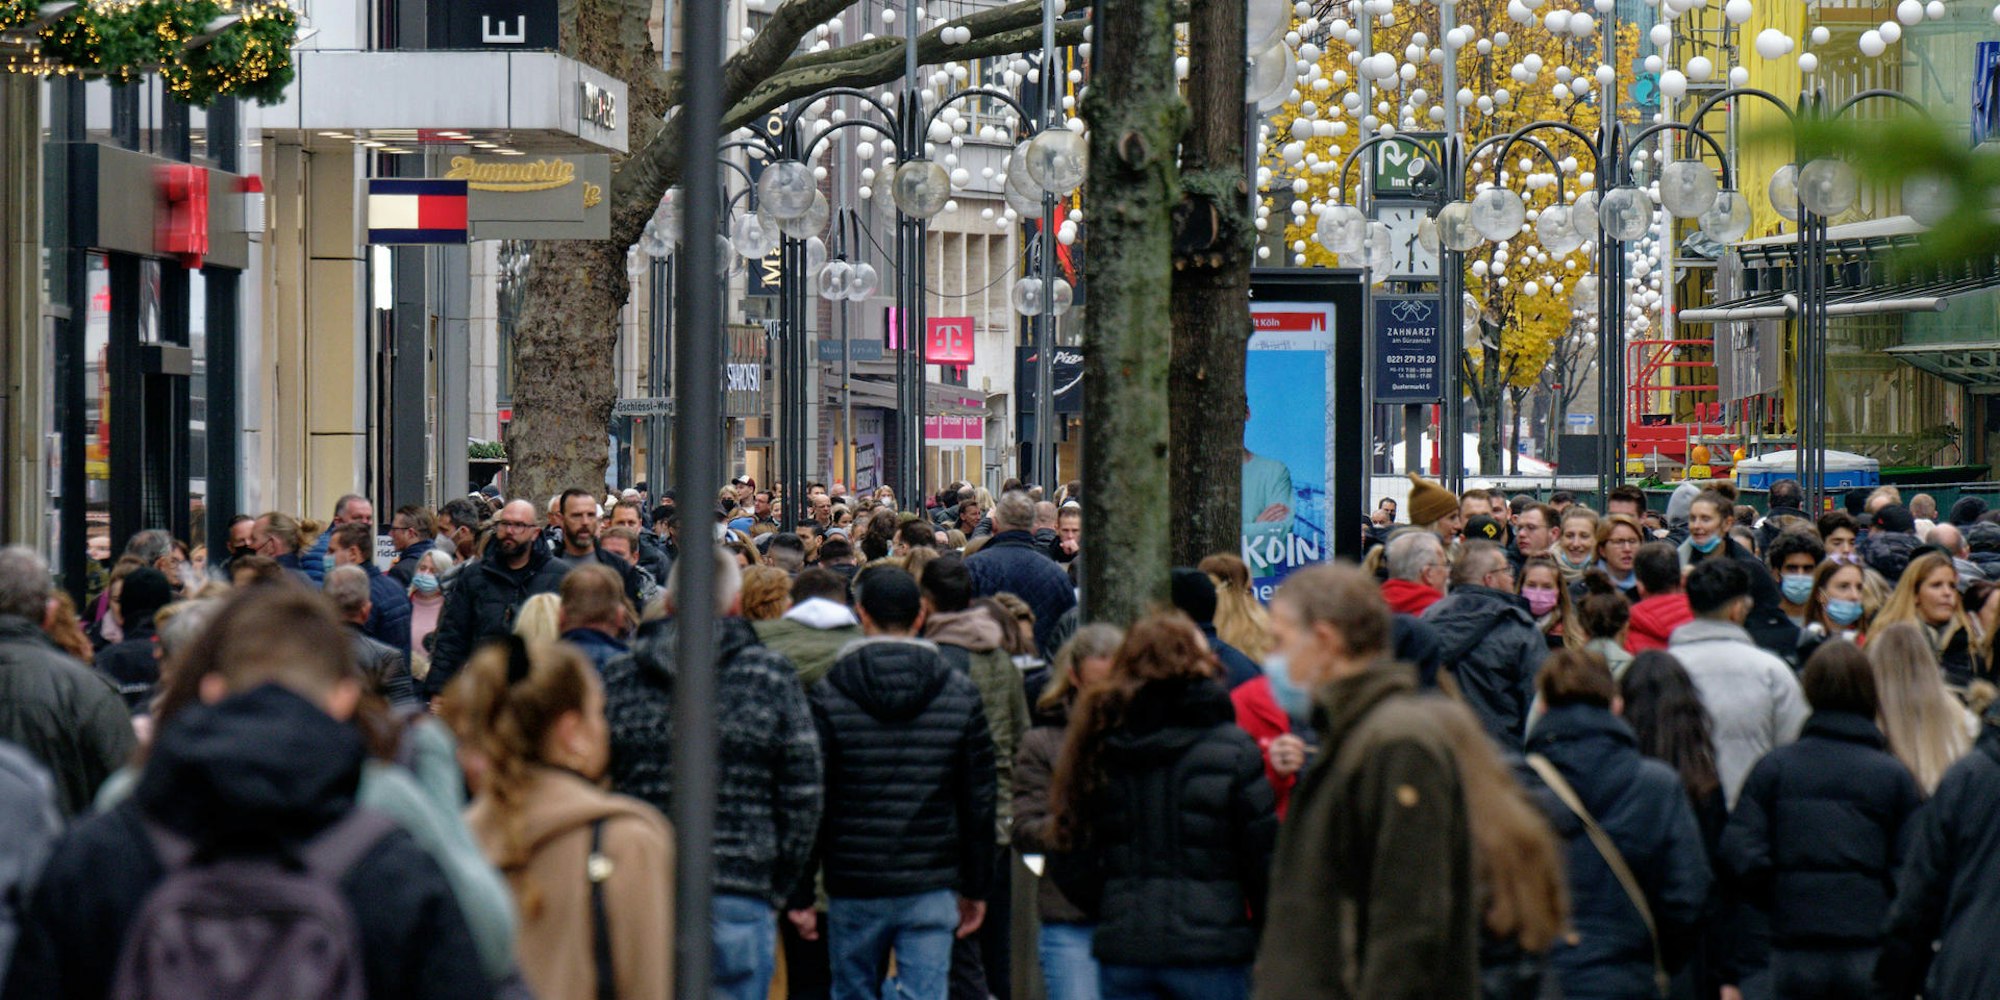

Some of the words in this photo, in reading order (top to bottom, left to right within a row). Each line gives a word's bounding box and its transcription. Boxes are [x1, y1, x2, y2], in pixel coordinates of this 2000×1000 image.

[482, 15, 526, 43] E
[1391, 176, 1405, 187] Im
[1387, 327, 1436, 336] ZAHNARZT
[1387, 355, 1403, 363] 0221
[1404, 355, 1416, 363] 271
[1417, 355, 1425, 363] 21
[1426, 355, 1436, 363] 20
